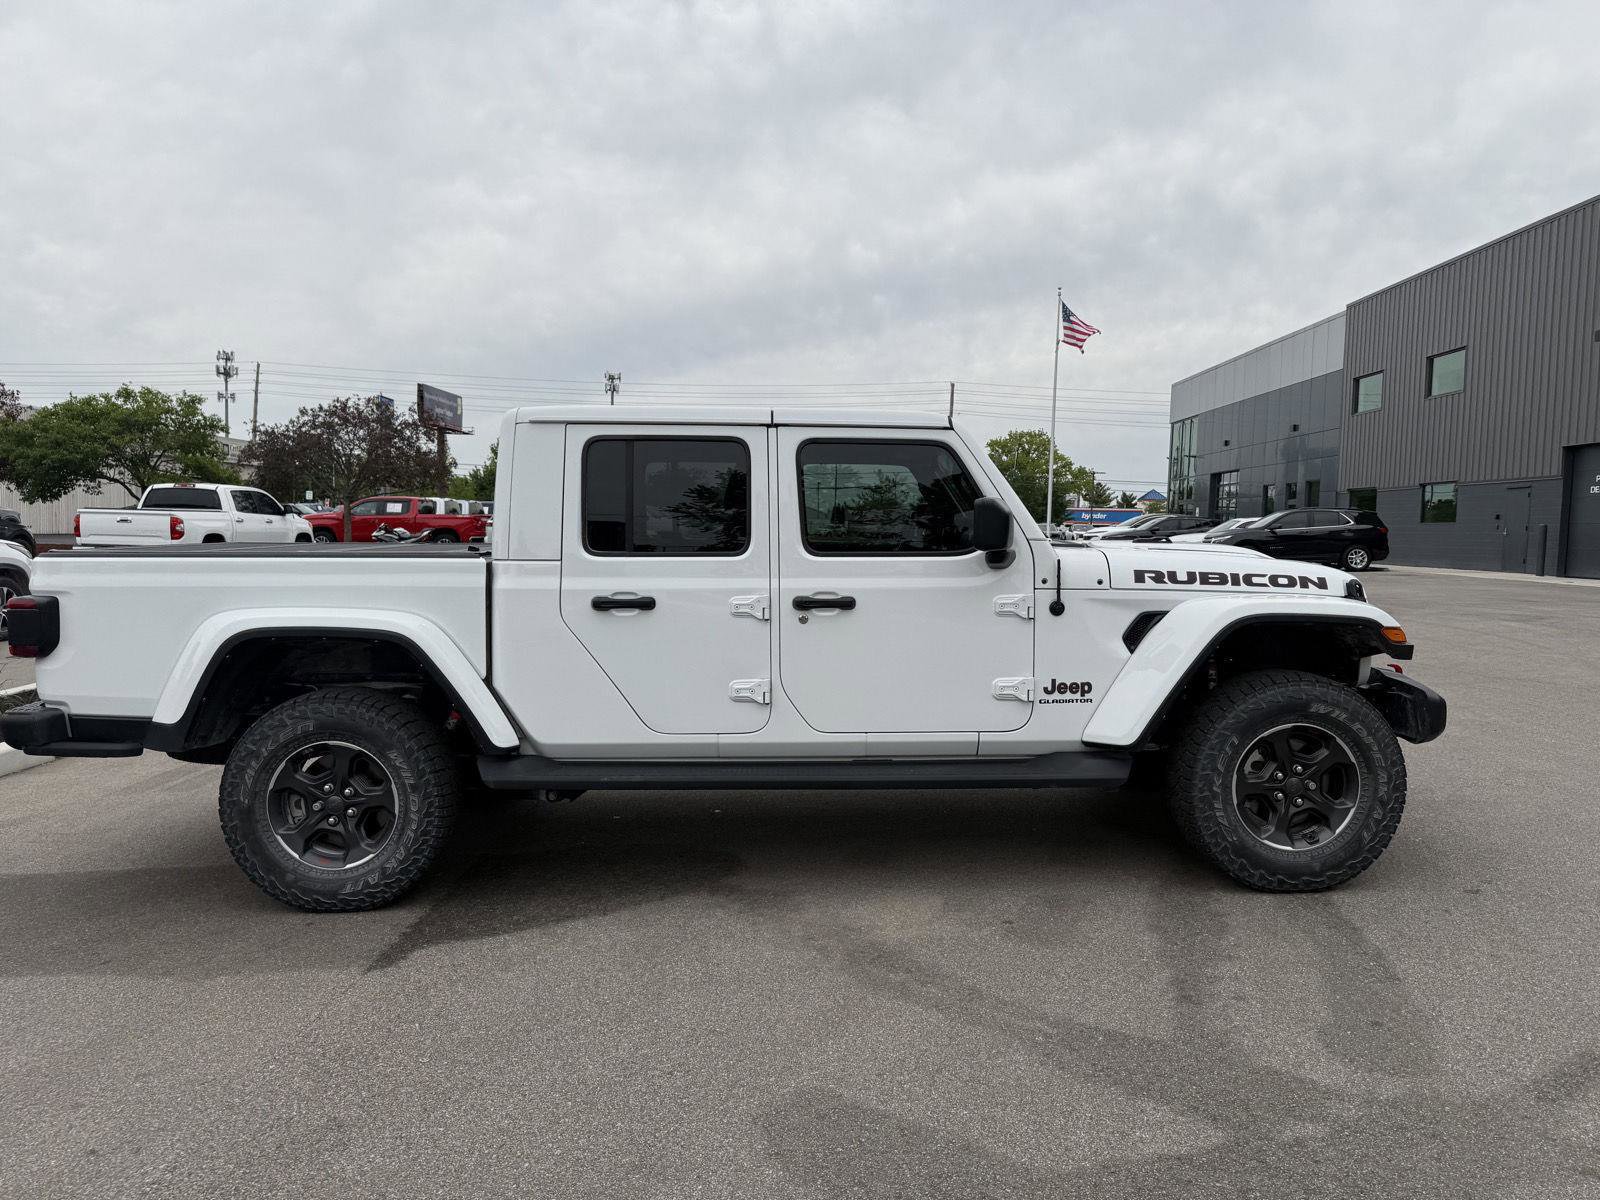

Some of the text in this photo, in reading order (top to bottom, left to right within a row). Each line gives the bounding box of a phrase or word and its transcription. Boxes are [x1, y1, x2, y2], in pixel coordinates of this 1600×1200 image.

[1133, 569, 1328, 590] RUBICON
[1043, 678, 1092, 697] Jeep
[386, 751, 419, 875] WILDPEAK
